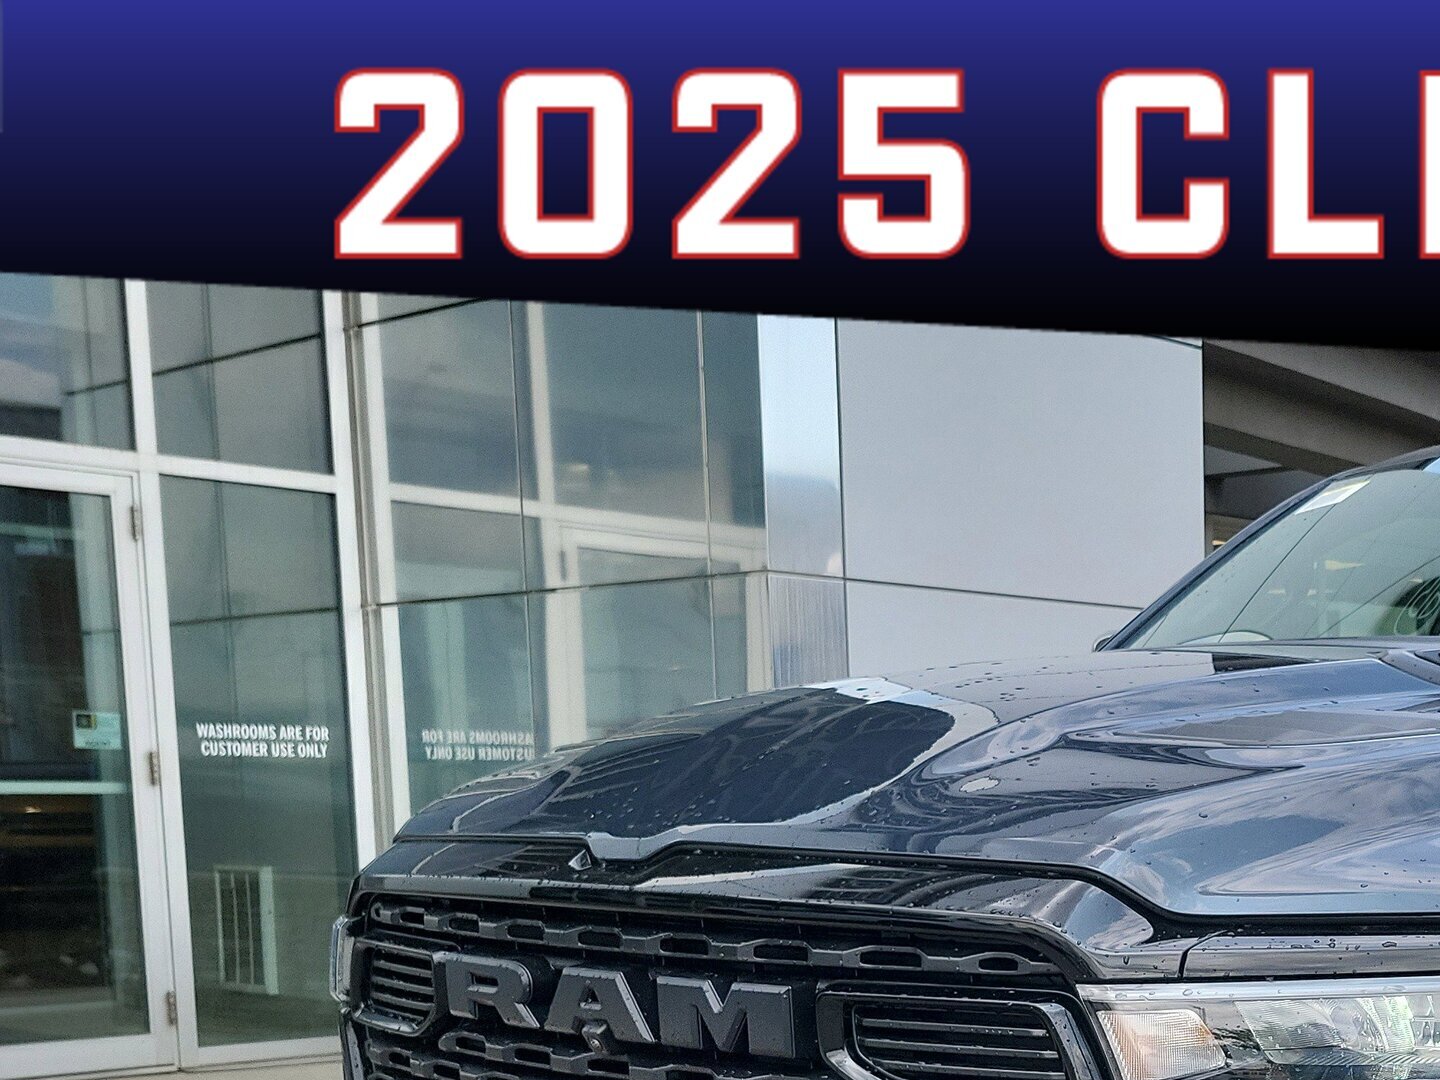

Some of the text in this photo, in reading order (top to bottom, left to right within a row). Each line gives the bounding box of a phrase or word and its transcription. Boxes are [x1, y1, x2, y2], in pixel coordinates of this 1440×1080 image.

[196, 722, 330, 741] WASHROOMS ARE FOR
[200, 740, 328, 758] CUSTOMER USE ONLY
[444, 951, 797, 1058] RAM
